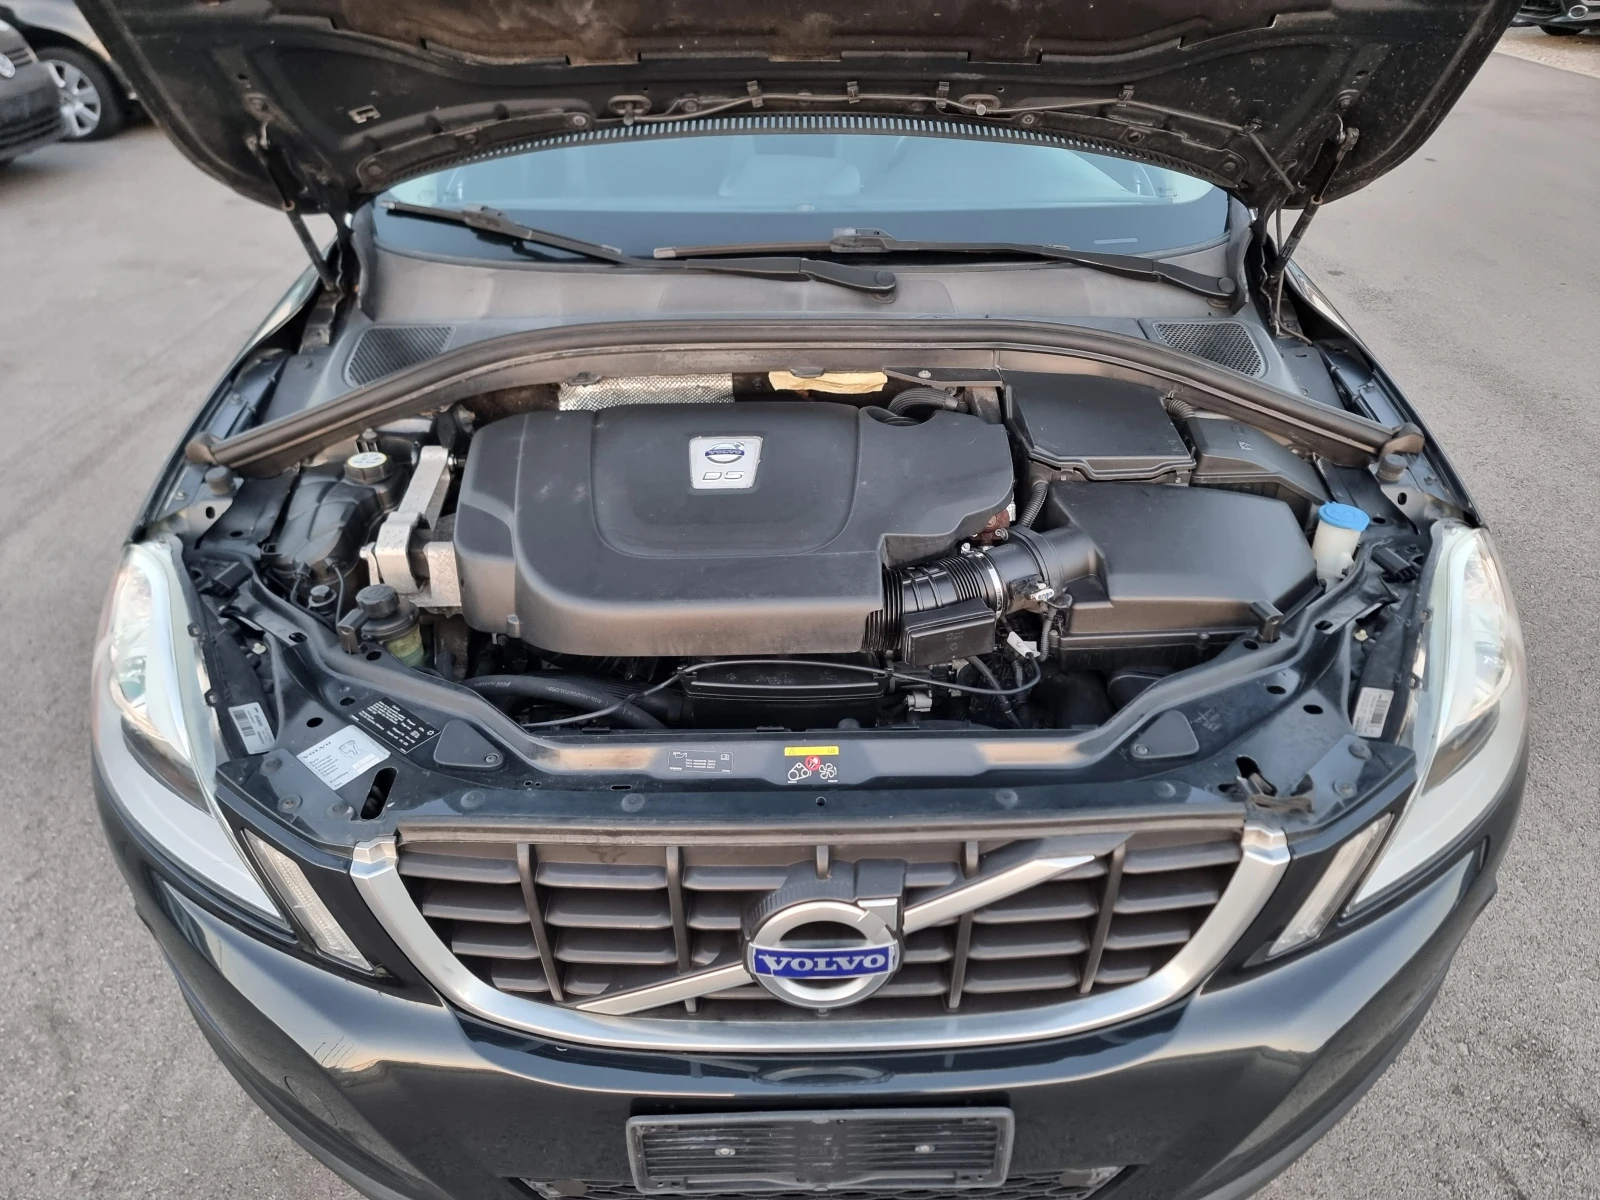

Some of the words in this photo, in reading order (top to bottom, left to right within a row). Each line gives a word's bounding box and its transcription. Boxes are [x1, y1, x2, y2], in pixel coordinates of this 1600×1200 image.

[702, 471, 744, 480] D5
[303, 741, 332, 759] VOLVO
[758, 954, 885, 971] VOLVO
